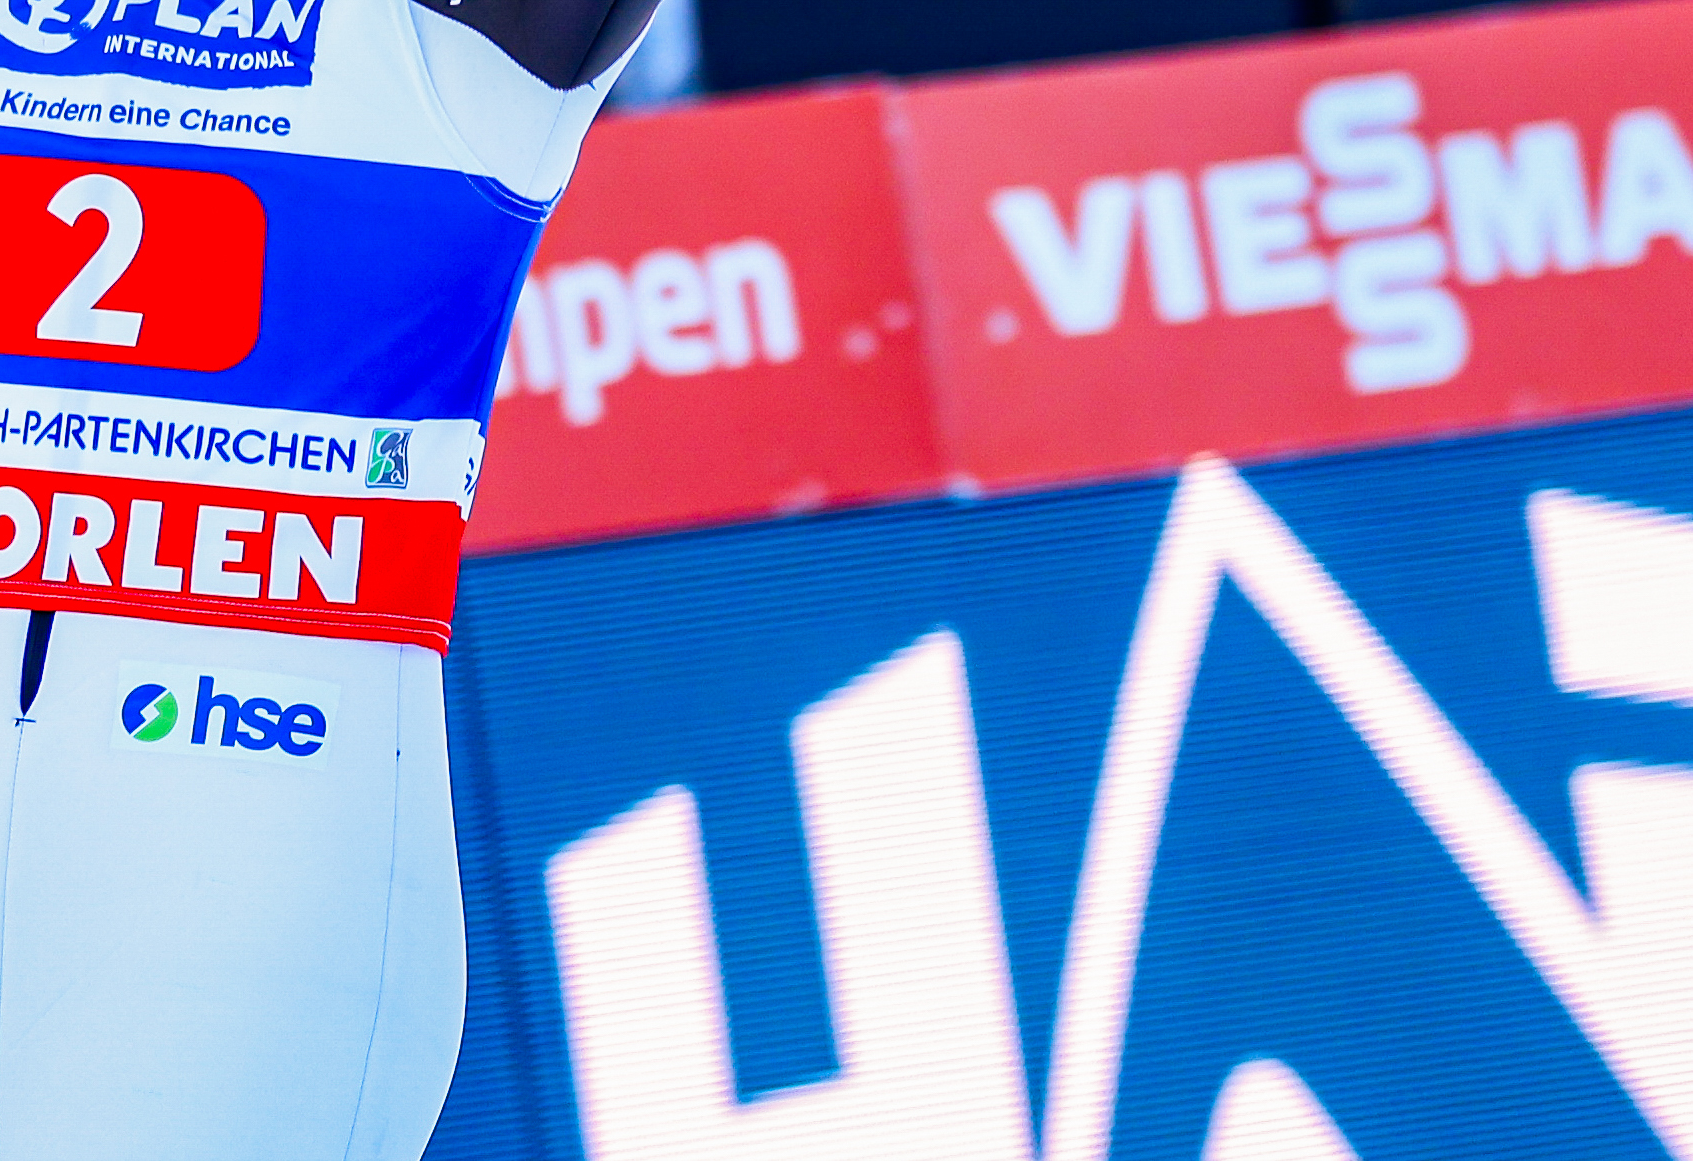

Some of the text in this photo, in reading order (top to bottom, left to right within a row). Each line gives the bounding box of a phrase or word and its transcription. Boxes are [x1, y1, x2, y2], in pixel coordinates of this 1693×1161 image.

[103, 35, 295, 70] INTERNATIONAL
[0, 89, 103, 124] Kindern
[108, 101, 170, 128] eine
[179, 107, 292, 137] Chance
[36, 173, 145, 348] 2
[989, 71, 1693, 397] VIESSMA
[190, 675, 327, 757] hse
